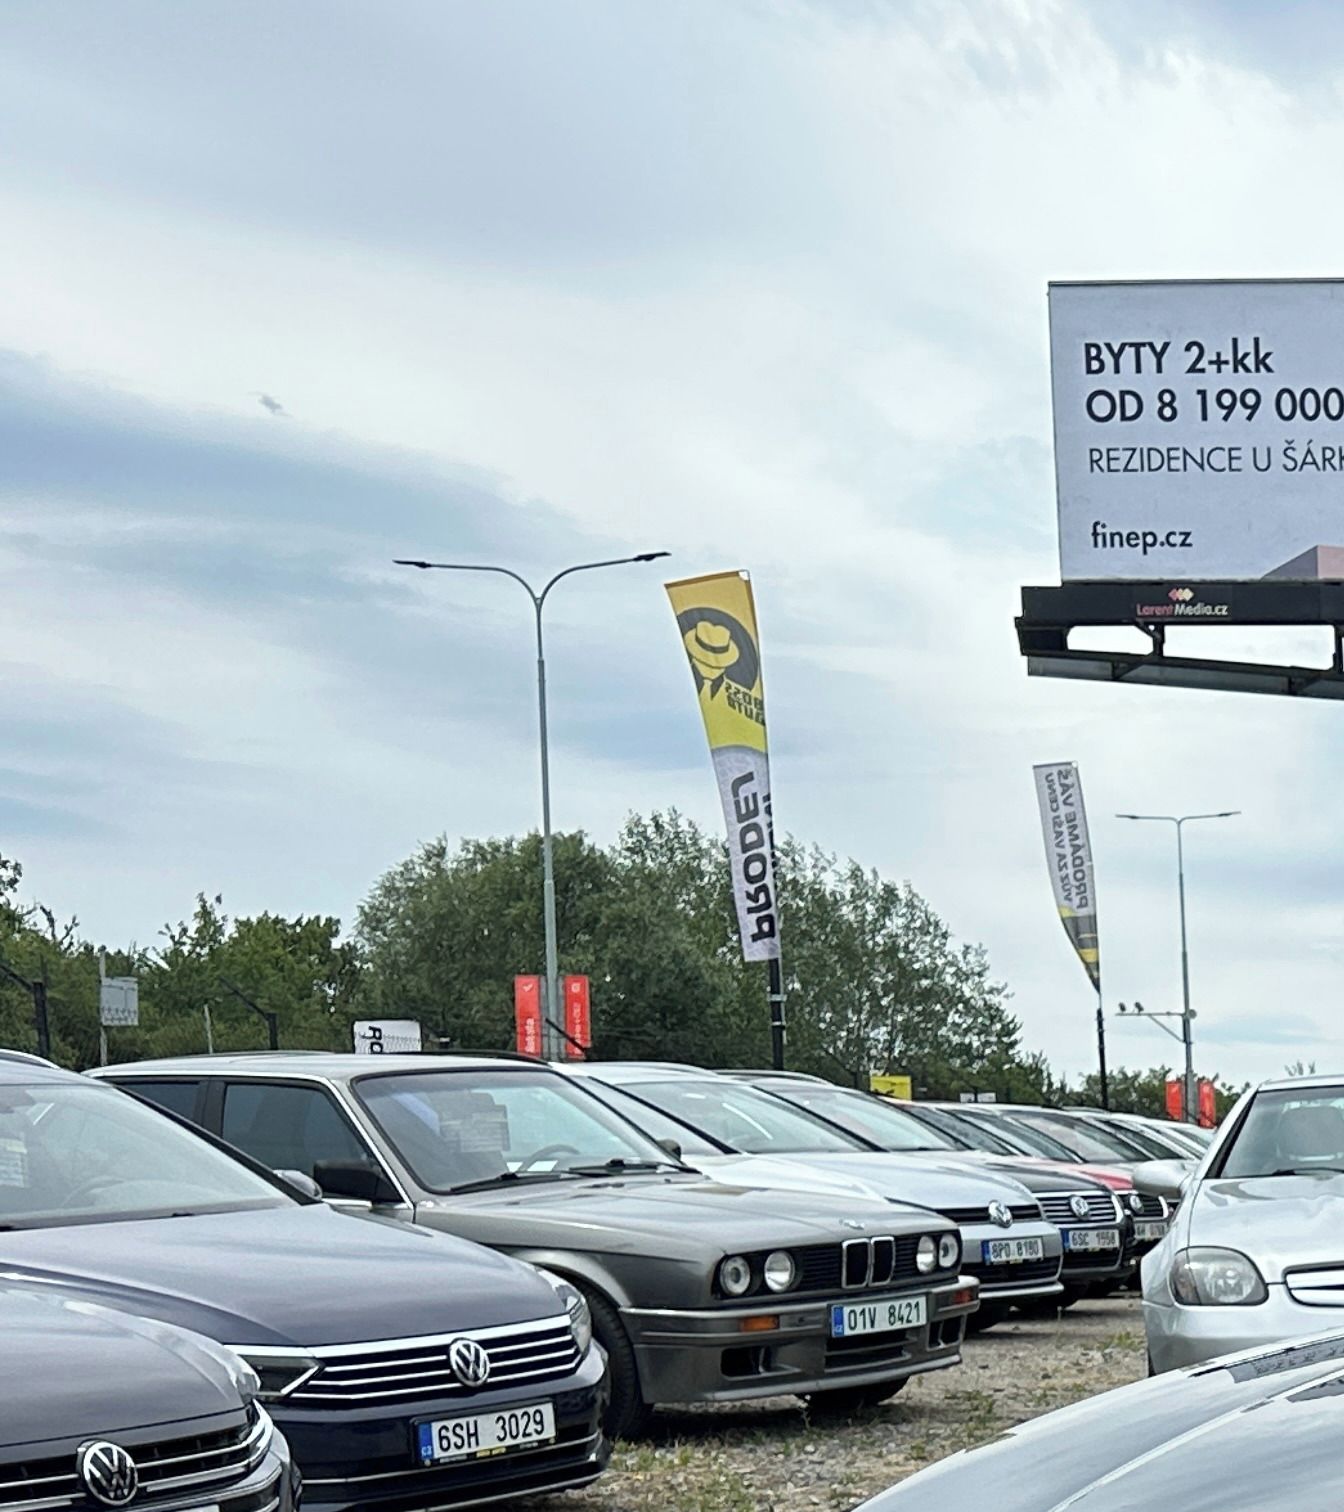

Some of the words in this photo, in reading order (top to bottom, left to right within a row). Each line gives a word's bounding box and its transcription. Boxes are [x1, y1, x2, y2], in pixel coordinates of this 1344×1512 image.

[1084, 341, 1171, 374] BYTY
[1184, 336, 1275, 374] 2+kk
[1085, 389, 1144, 423] OD
[1156, 388, 1178, 422] 8
[1196, 388, 1262, 422] 199
[1274, 387, 1344, 422] 000
[1089, 447, 1243, 474] REZIDENCE
[1252, 446, 1271, 473] U
[1091, 520, 1193, 555] finep.cz
[848, 1306, 877, 1331] 01V
[888, 1300, 921, 1326] 8421
[438, 1418, 480, 1452] 6SH
[495, 1408, 545, 1443] 3029
